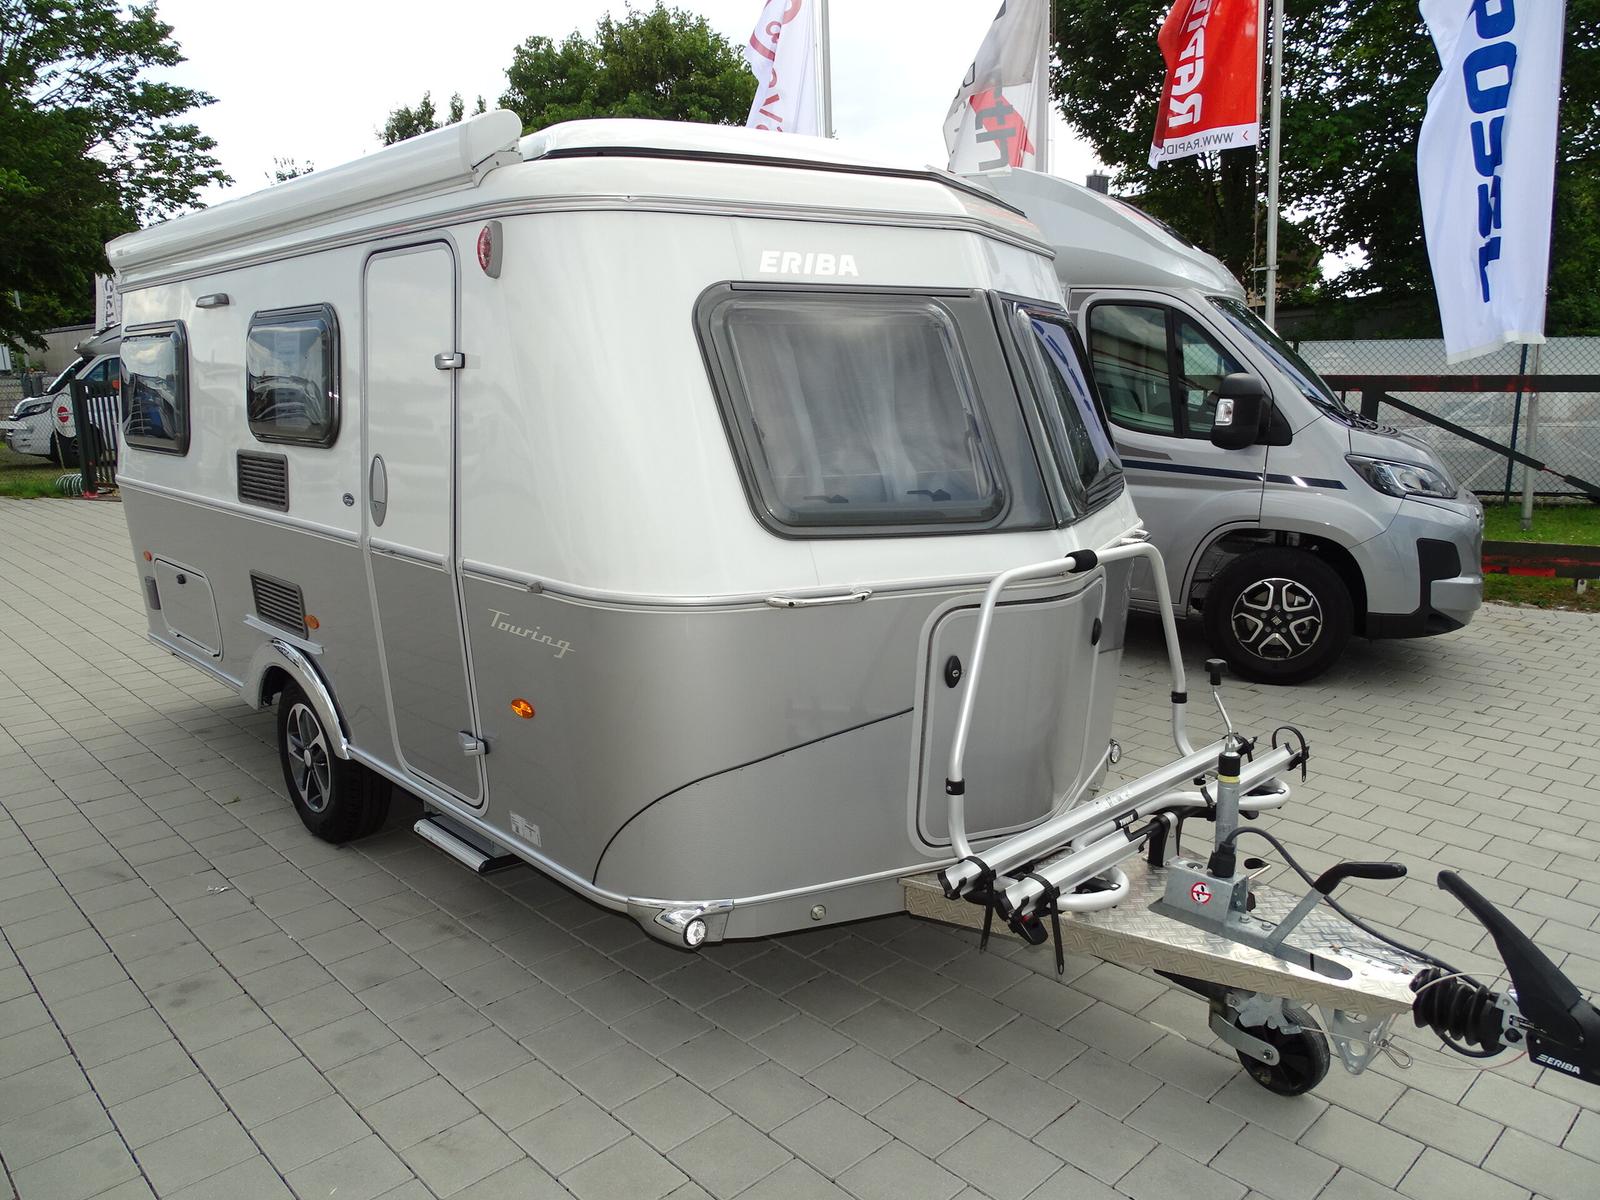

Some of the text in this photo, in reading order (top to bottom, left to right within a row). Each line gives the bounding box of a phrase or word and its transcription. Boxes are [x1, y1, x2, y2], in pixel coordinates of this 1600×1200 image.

[760, 250, 859, 277] ERIBA
[487, 608, 576, 658] Touring
[1546, 1057, 1581, 1075] ERIBA
